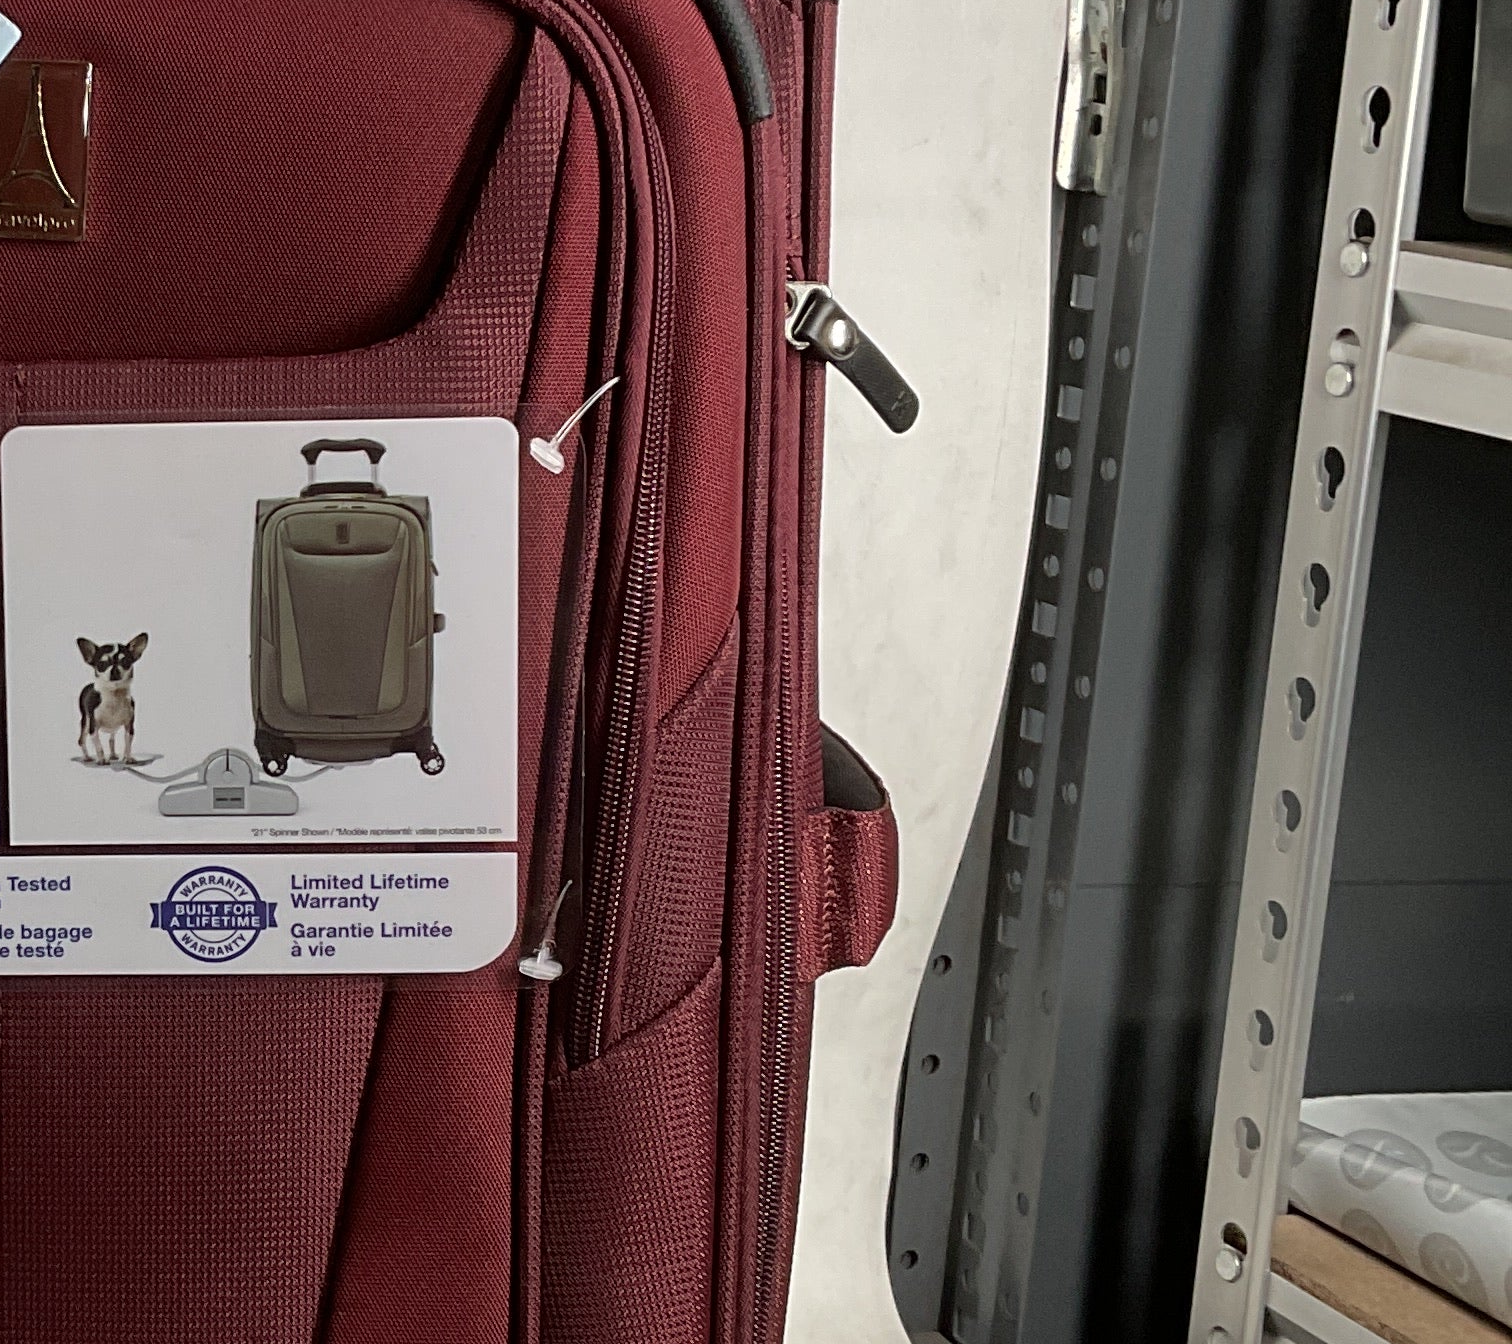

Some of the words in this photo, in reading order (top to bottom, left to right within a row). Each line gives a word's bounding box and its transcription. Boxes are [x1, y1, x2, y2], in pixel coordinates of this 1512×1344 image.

[301, 828, 330, 837] Shown
[7, 876, 71, 891] Tested
[180, 875, 248, 897] WARRANTY
[291, 874, 363, 889] Limited
[371, 874, 449, 889] Lifetime
[175, 904, 218, 915] BUILT
[224, 904, 255, 915] FOR
[291, 894, 379, 911] Warranty
[170, 917, 180, 927] A
[187, 916, 260, 927] LIFETIME
[21, 925, 92, 942] bagage
[291, 923, 374, 938] Garantie
[381, 921, 453, 937] Limitée
[16, 942, 64, 957] testé
[181, 933, 246, 956] WARRANTY
[291, 941, 301, 957] à
[308, 942, 336, 956] vie
